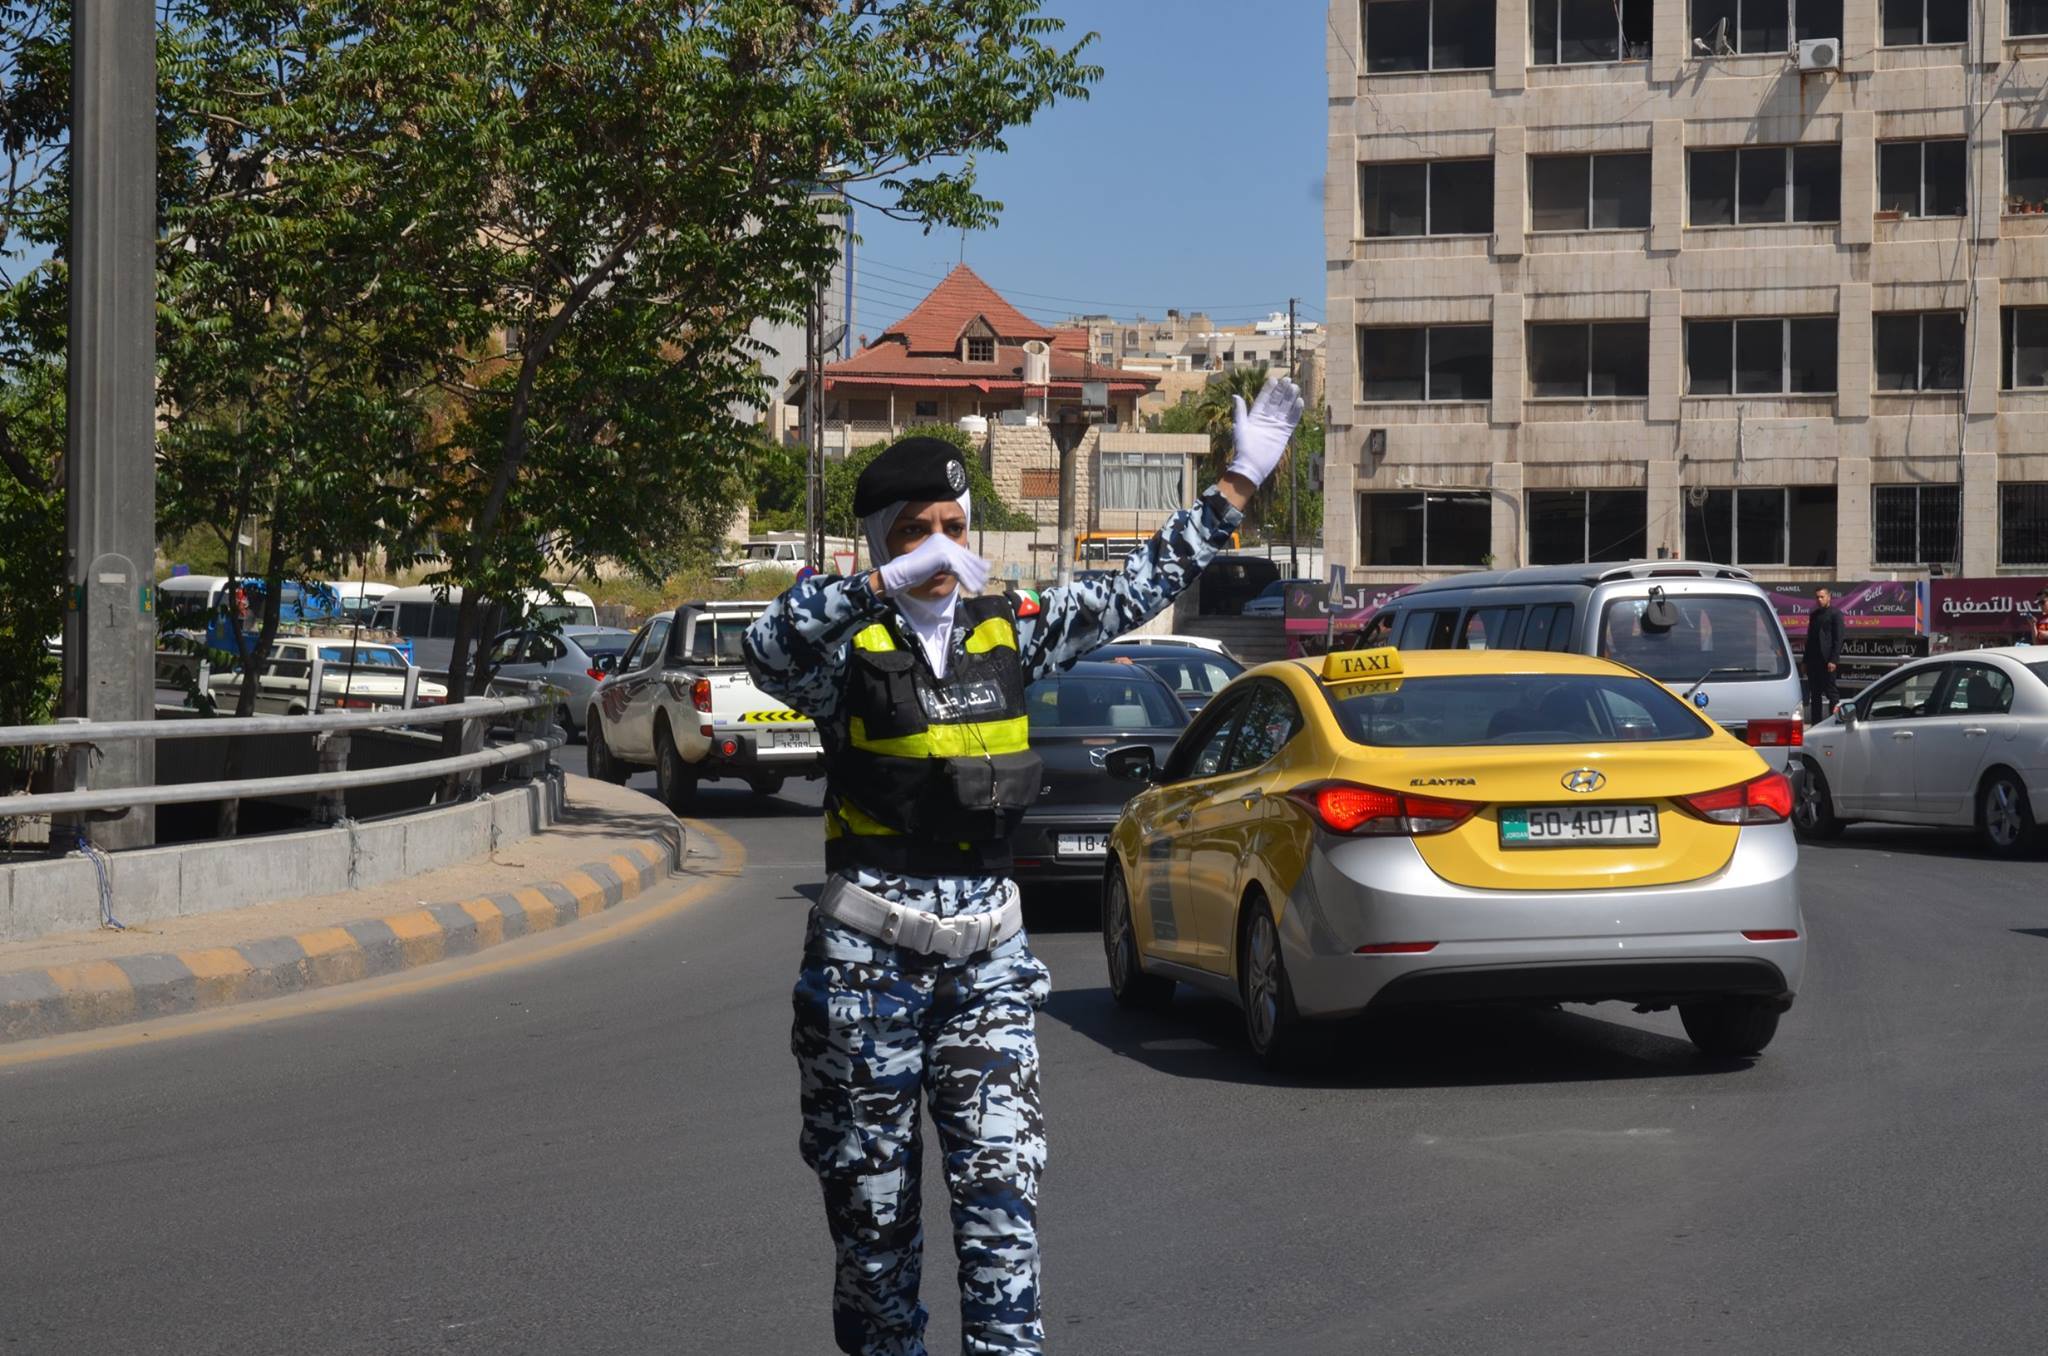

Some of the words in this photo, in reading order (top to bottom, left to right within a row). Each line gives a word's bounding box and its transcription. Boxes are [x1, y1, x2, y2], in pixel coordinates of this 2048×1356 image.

[1942, 596, 2013, 618] للتصفية
[1341, 655, 1391, 673] TAXI
[1409, 777, 1477, 787] ELANTRA
